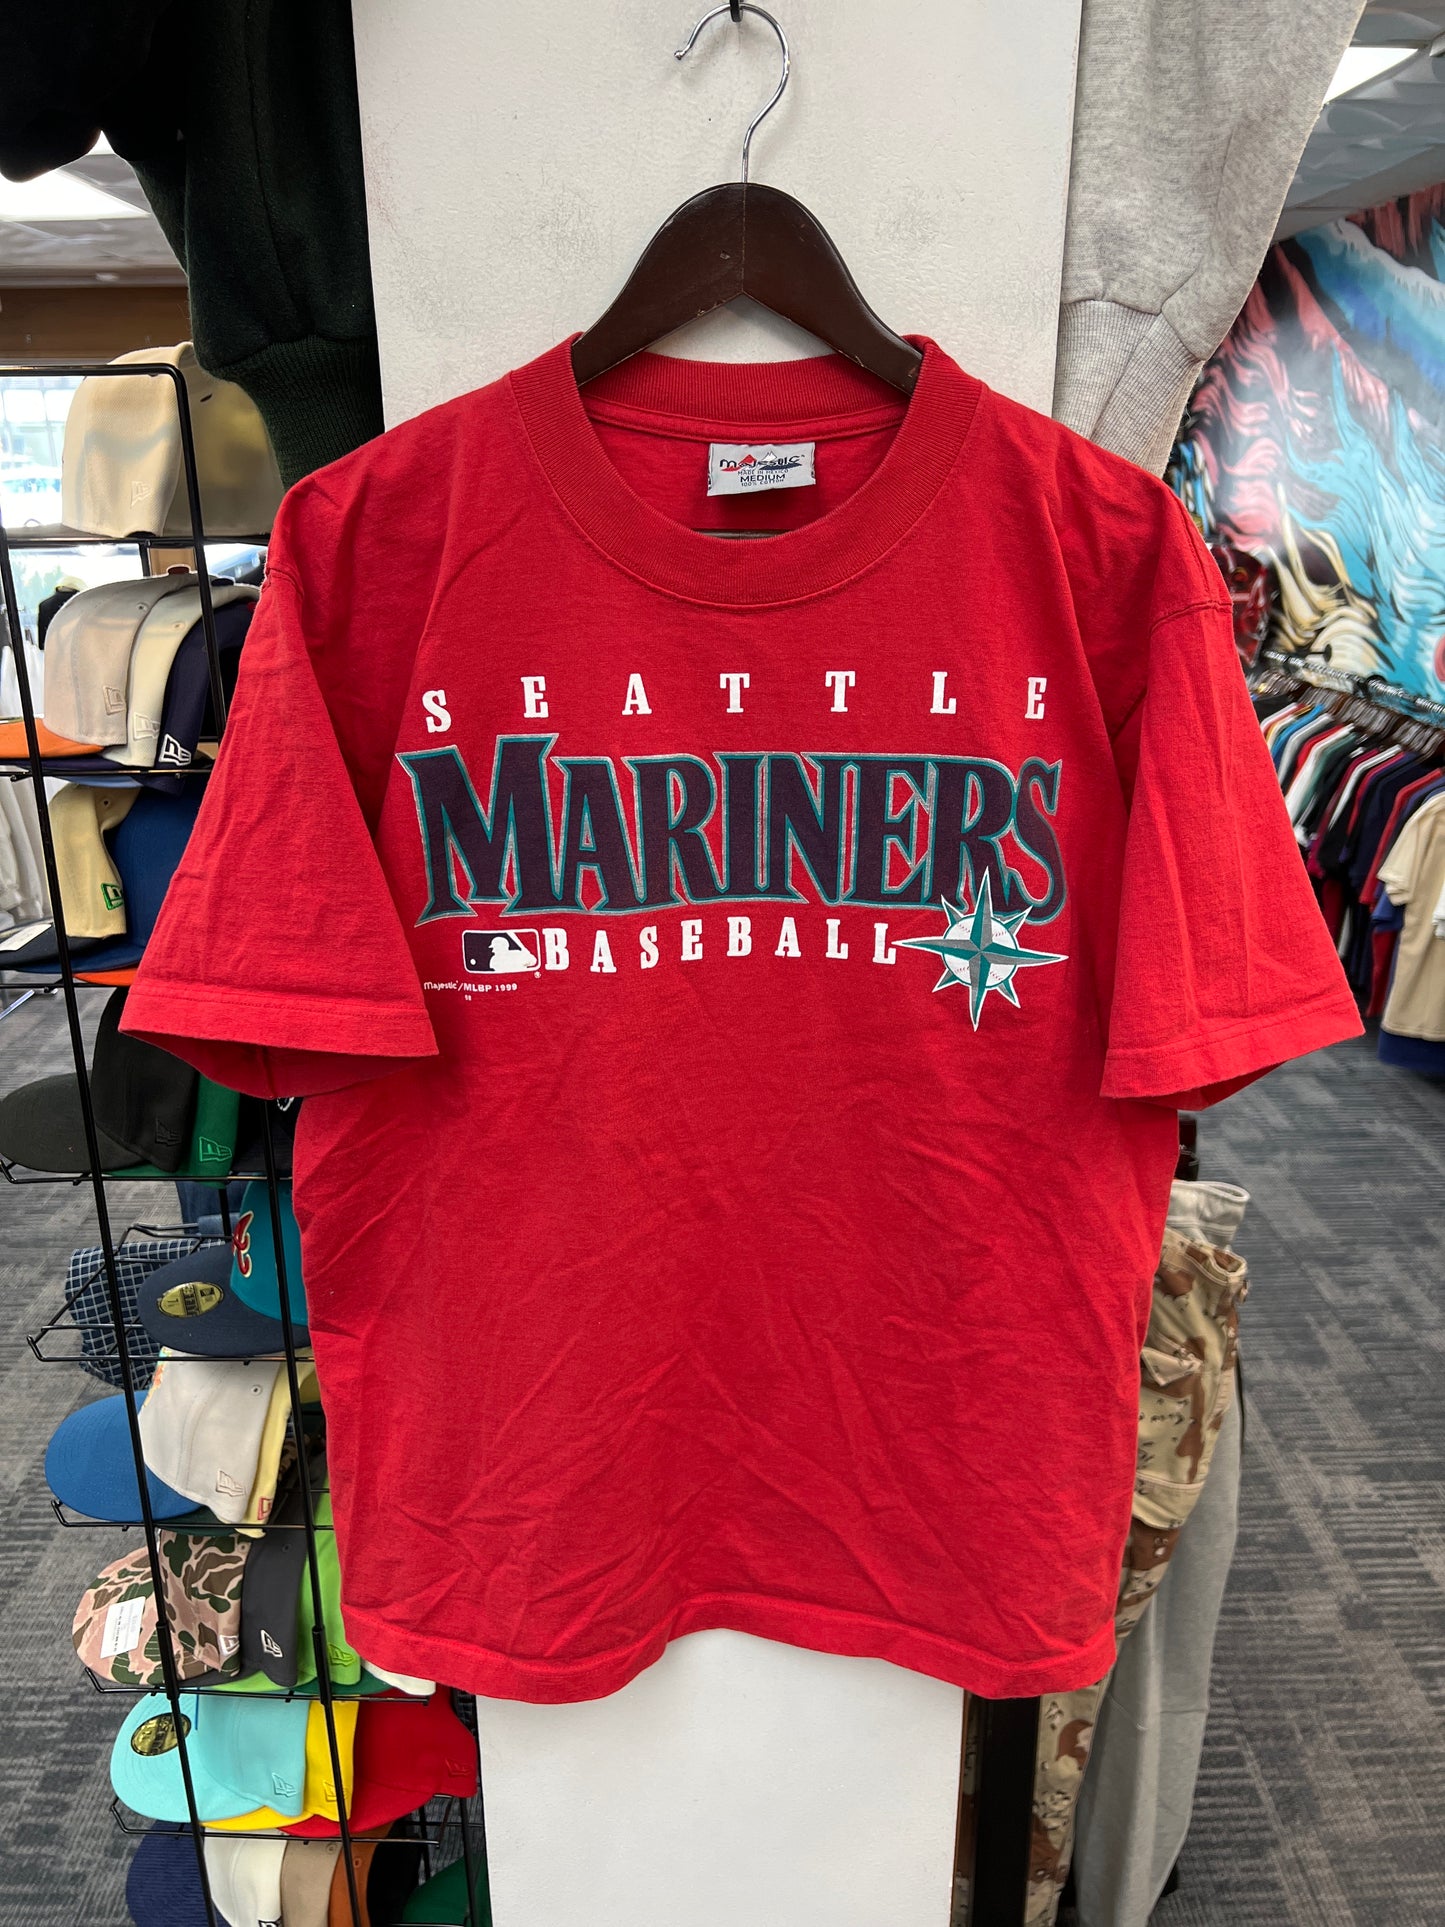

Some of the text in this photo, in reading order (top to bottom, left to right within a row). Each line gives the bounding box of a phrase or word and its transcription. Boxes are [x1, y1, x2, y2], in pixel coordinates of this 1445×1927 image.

[740, 474, 785, 482] MEDIUM
[422, 671, 1047, 733] SEATTLE
[395, 733, 1068, 926] MARINERS
[542, 917, 896, 973] BASEBALL
[495, 983, 518, 992] 1999
